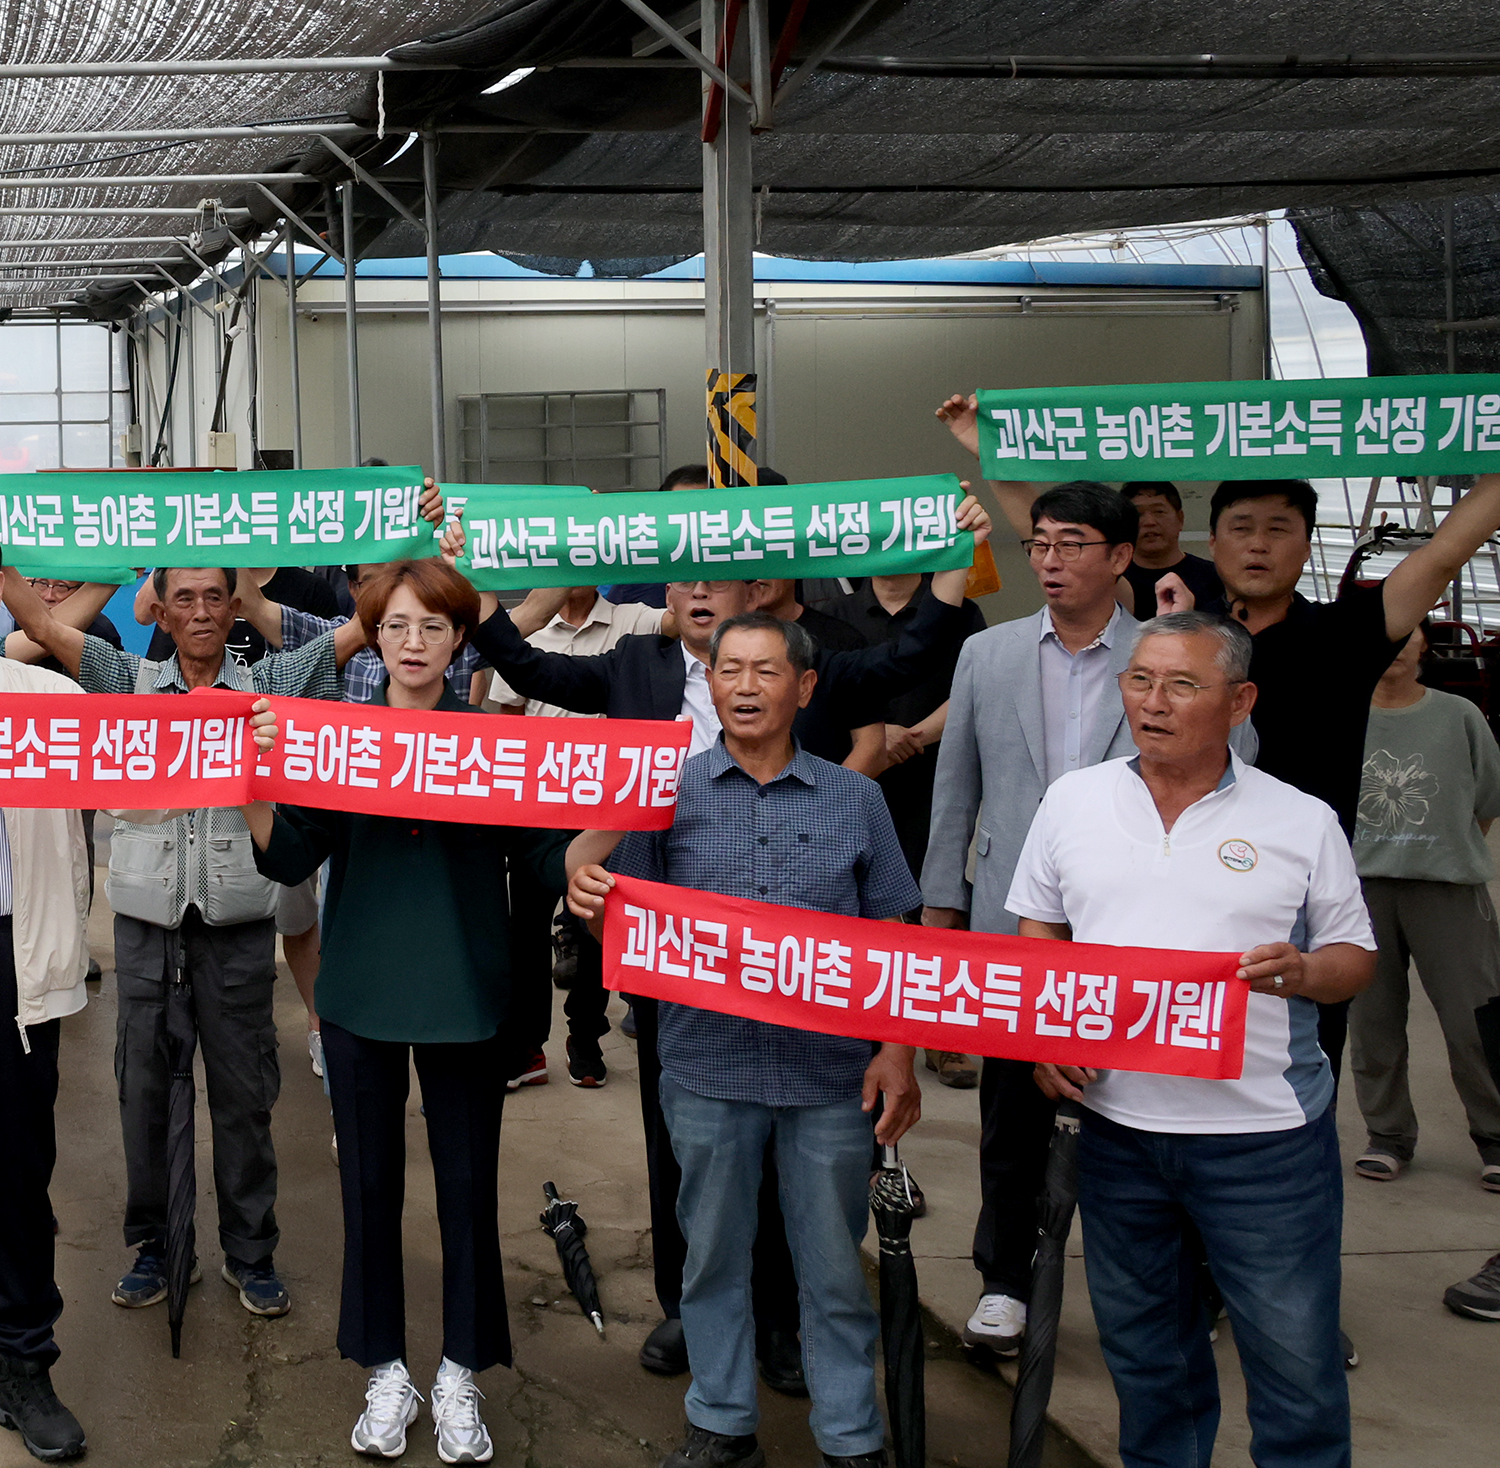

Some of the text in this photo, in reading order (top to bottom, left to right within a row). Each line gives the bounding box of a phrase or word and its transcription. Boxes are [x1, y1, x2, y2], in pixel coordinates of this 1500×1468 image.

[995, 408, 1087, 460] 괴산군
[1096, 403, 1193, 459] 농어촌
[1205, 400, 1342, 456] 기본소득
[1356, 397, 1425, 454] 선정
[72, 494, 156, 547] 농어촌
[165, 491, 278, 546] 기본소득
[288, 490, 344, 543] 선정
[355, 486, 421, 540] 기원!
[469, 517, 558, 569] 괴산군
[567, 513, 659, 565] 농어촌
[668, 506, 795, 562] 기본소득
[806, 501, 869, 556] 선정
[881, 494, 958, 551] 기원!
[92, 719, 158, 780] 선정
[168, 717, 244, 778] 기원!
[284, 726, 381, 788] 농어촌
[391, 733, 526, 801] 기본소득
[538, 742, 607, 805] 선정
[621, 904, 1225, 1050] 괴산군 농어촌 기본소득 선정 기원!
